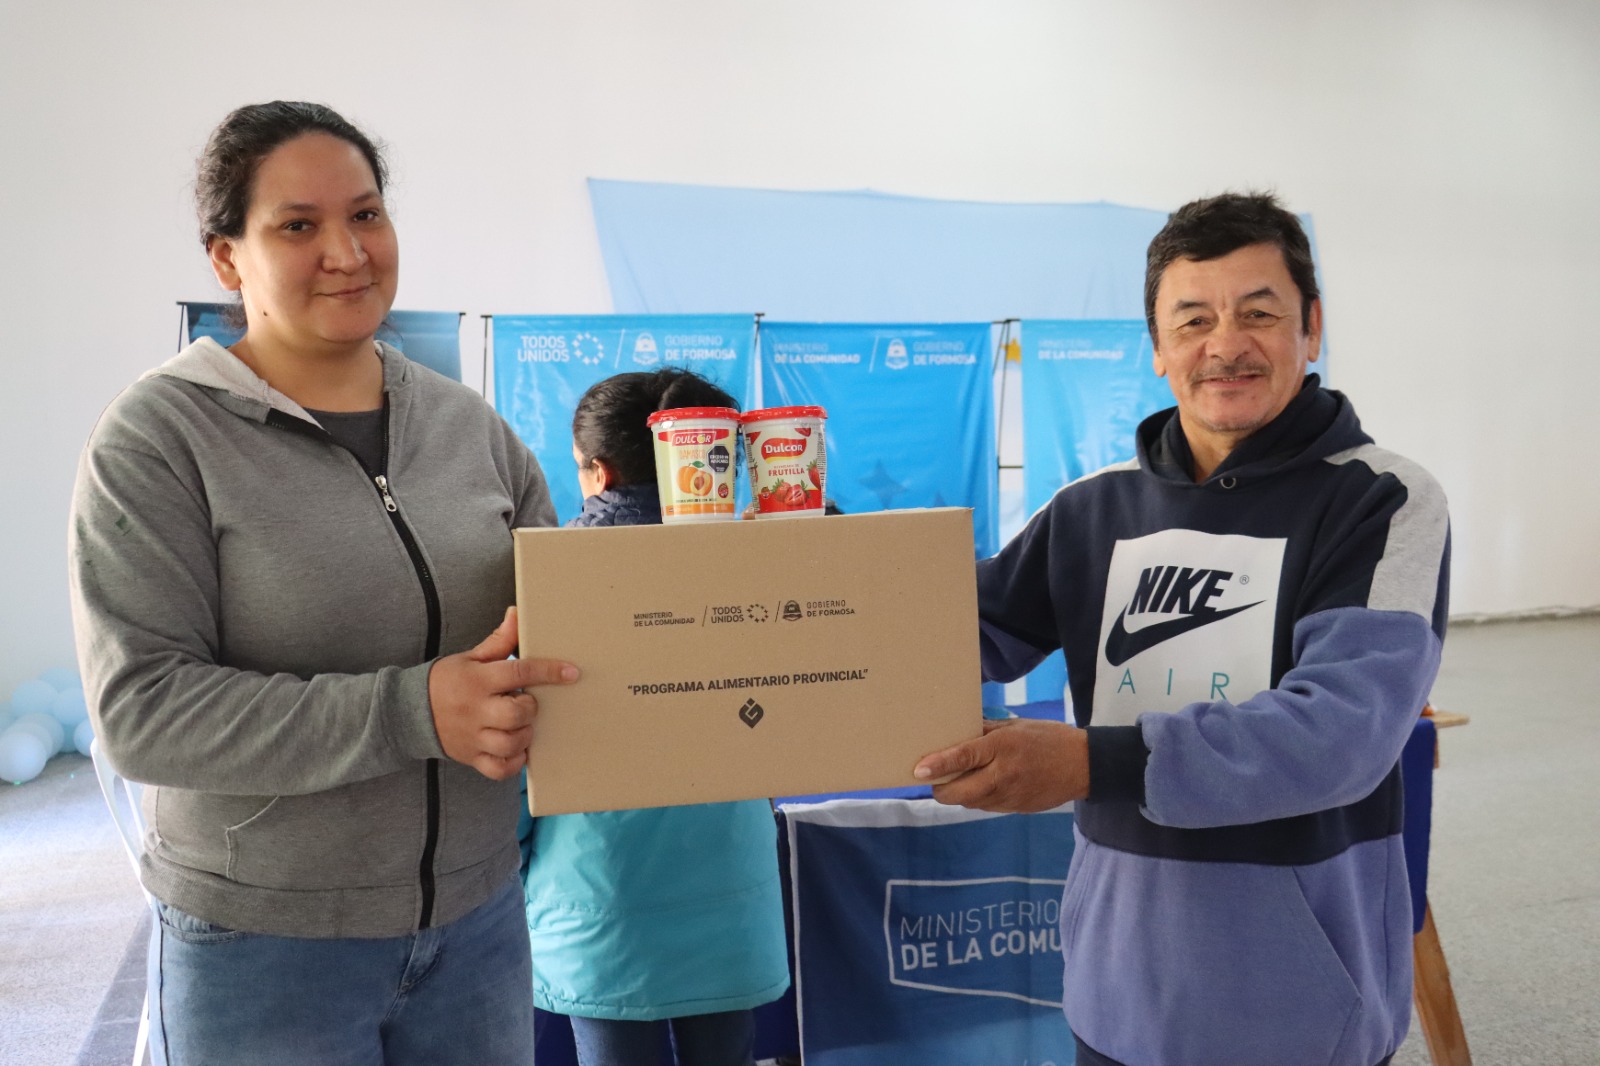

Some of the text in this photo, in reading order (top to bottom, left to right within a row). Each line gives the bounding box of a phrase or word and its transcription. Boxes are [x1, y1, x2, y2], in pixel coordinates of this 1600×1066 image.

[521, 335, 566, 349] TODOS
[665, 335, 724, 347] GOBIERNO
[518, 349, 570, 363] UNIDOS
[665, 348, 737, 361] DE FORMOSA
[789, 354, 802, 364] LA
[803, 354, 860, 364] COMUNIDAD
[913, 353, 976, 365] DE FORMOSA
[1053, 350, 1065, 360] LA
[675, 434, 712, 445] DULCOR
[768, 467, 805, 477] FRUTILLA
[1127, 565, 1234, 616] NIKE
[806, 600, 846, 609] GOBIERNO
[633, 611, 673, 620] MINISTERIO
[712, 606, 742, 616] TODOS
[818, 608, 856, 617] FORMOSA
[644, 619, 654, 627] LA
[654, 617, 696, 626] COMUNIDAD
[711, 615, 745, 624] UNIDOS
[707, 675, 791, 691] ALIMENTARIO
[1117, 667, 1230, 701] AIR
[900, 898, 1061, 940] MINISTERIO
[901, 942, 938, 971] DE
[947, 937, 983, 966] LA
